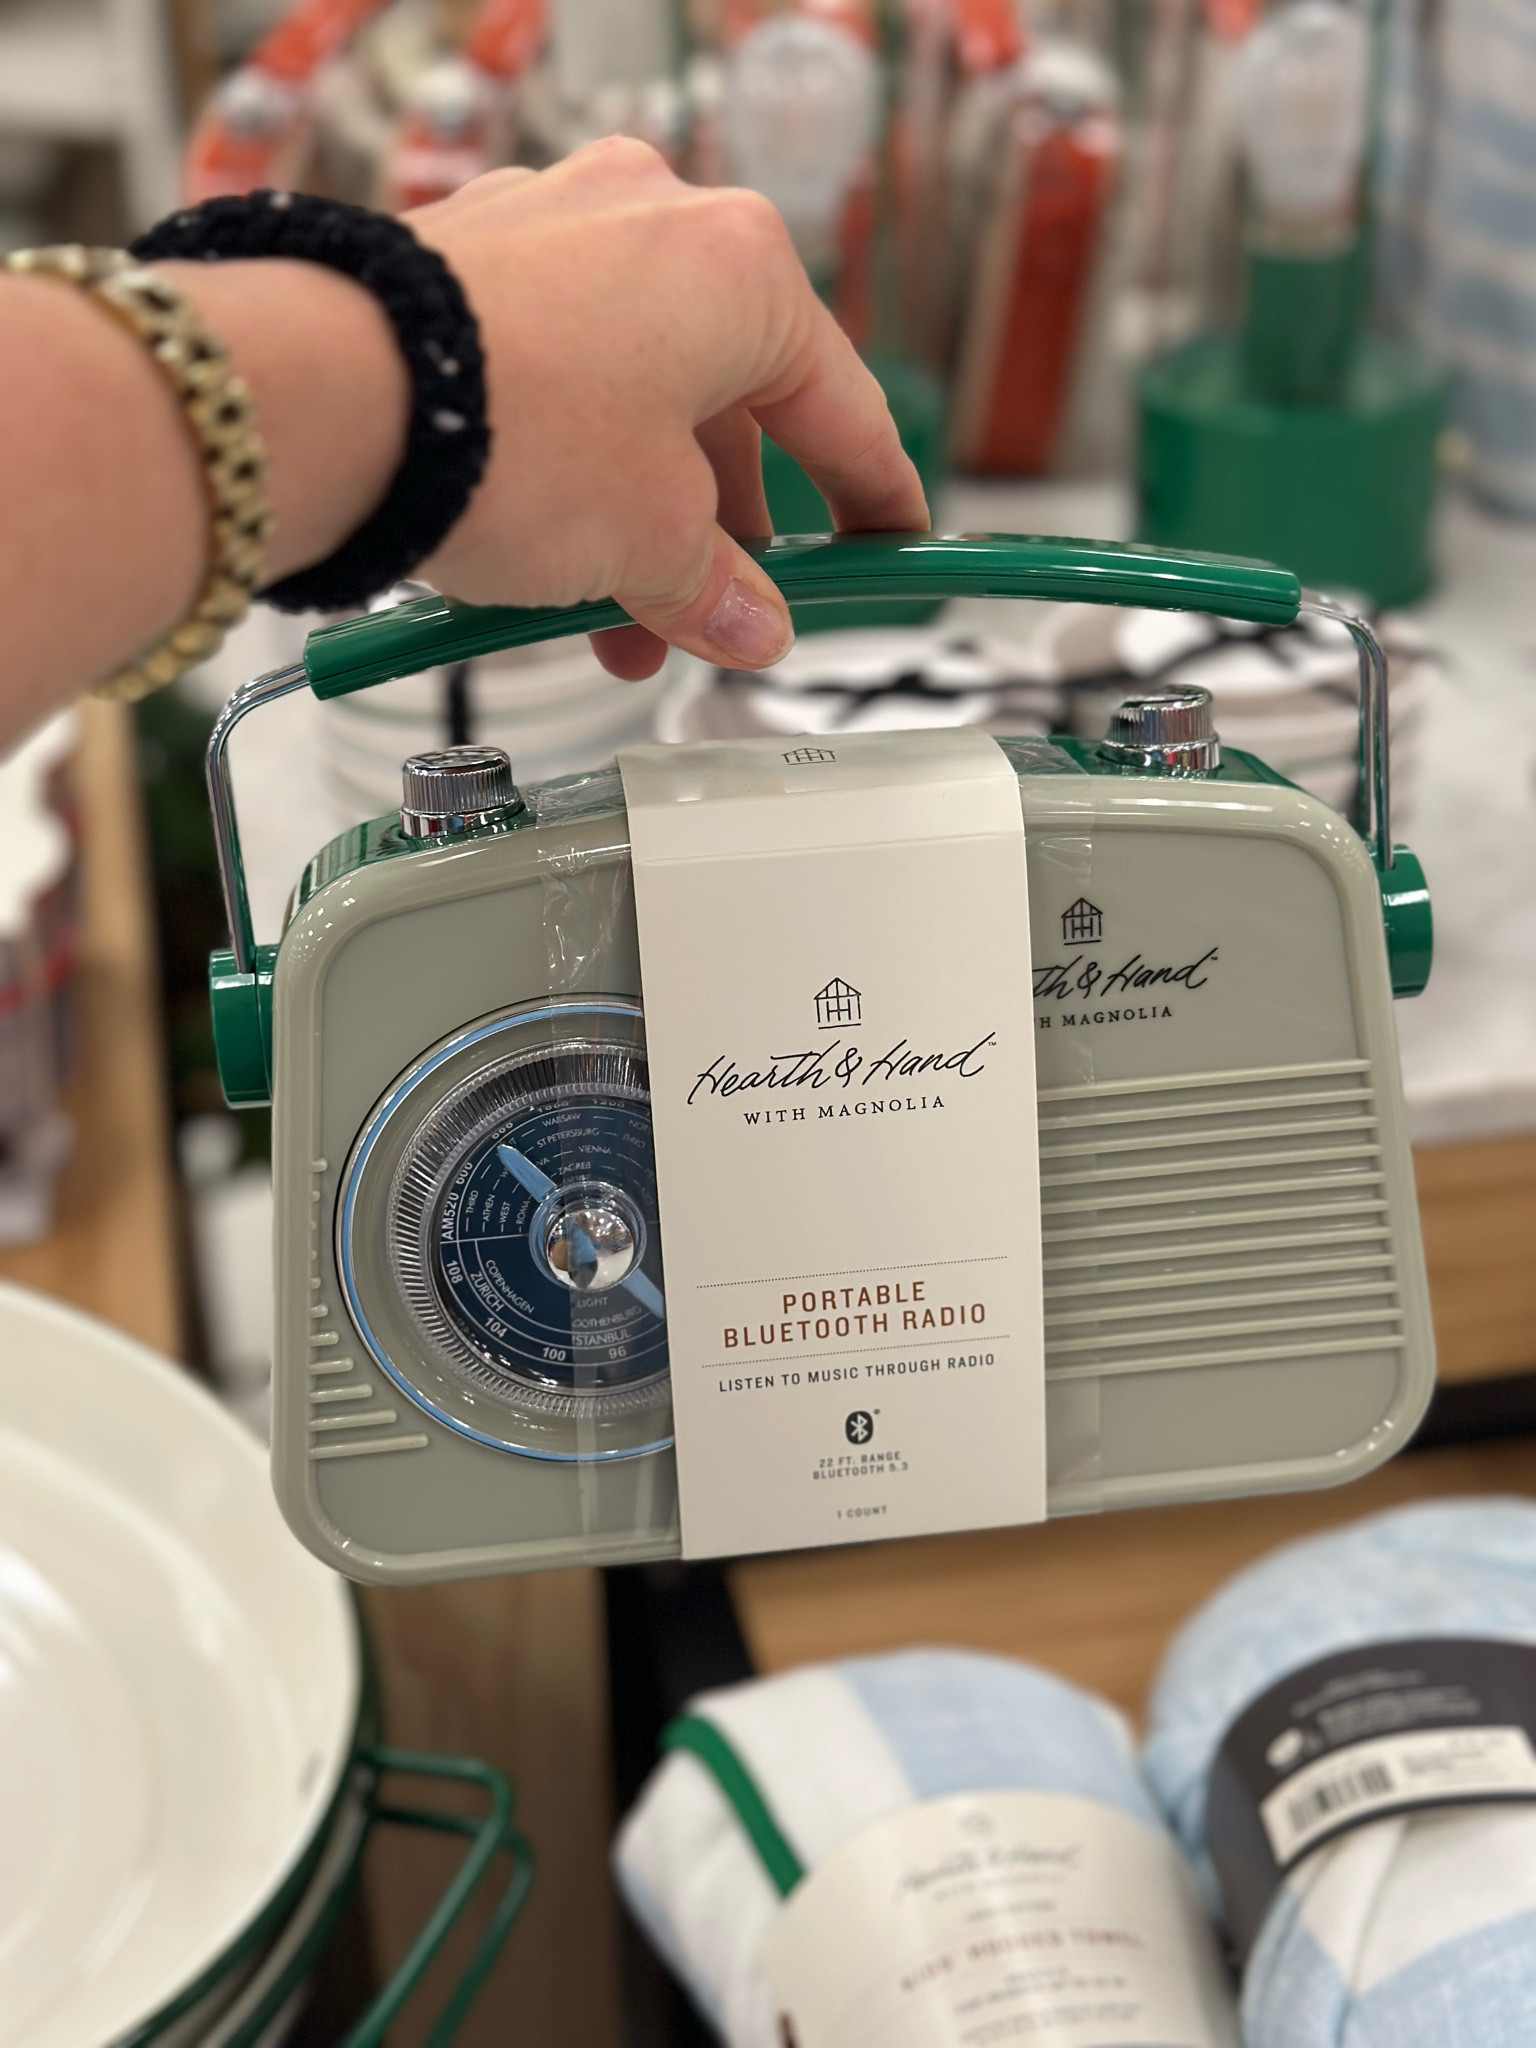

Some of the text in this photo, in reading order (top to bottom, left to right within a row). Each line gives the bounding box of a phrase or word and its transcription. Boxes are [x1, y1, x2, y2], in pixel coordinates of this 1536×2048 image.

[1077, 961, 1101, 999] &
[1062, 1006, 1173, 1027] MAGNOLIA
[687, 1040, 841, 1105] Hearth
[834, 1047, 863, 1088] &
[744, 1095, 946, 1125] WITH MAGNOLIA
[465, 1189, 479, 1214] THIRD
[483, 1193, 496, 1222] ATHEN
[499, 1201, 511, 1224] WEST
[446, 1259, 464, 1284] 108
[470, 1271, 506, 1313] ZURICH
[485, 1259, 535, 1314] COPENHAGEN
[782, 1281, 927, 1314] PORTABLE
[484, 1317, 508, 1338] 104
[723, 1303, 987, 1348] BLUETOOTH RADIO
[542, 1347, 567, 1361] 100
[719, 1353, 995, 1393] LISTEN TO MUSIC THROUGH RADIO
[812, 1461, 909, 1481] BLUETOOTH 5.3
[818, 1451, 902, 1469] 22 FT. RANGE
[846, 1505, 888, 1519] COUNT
